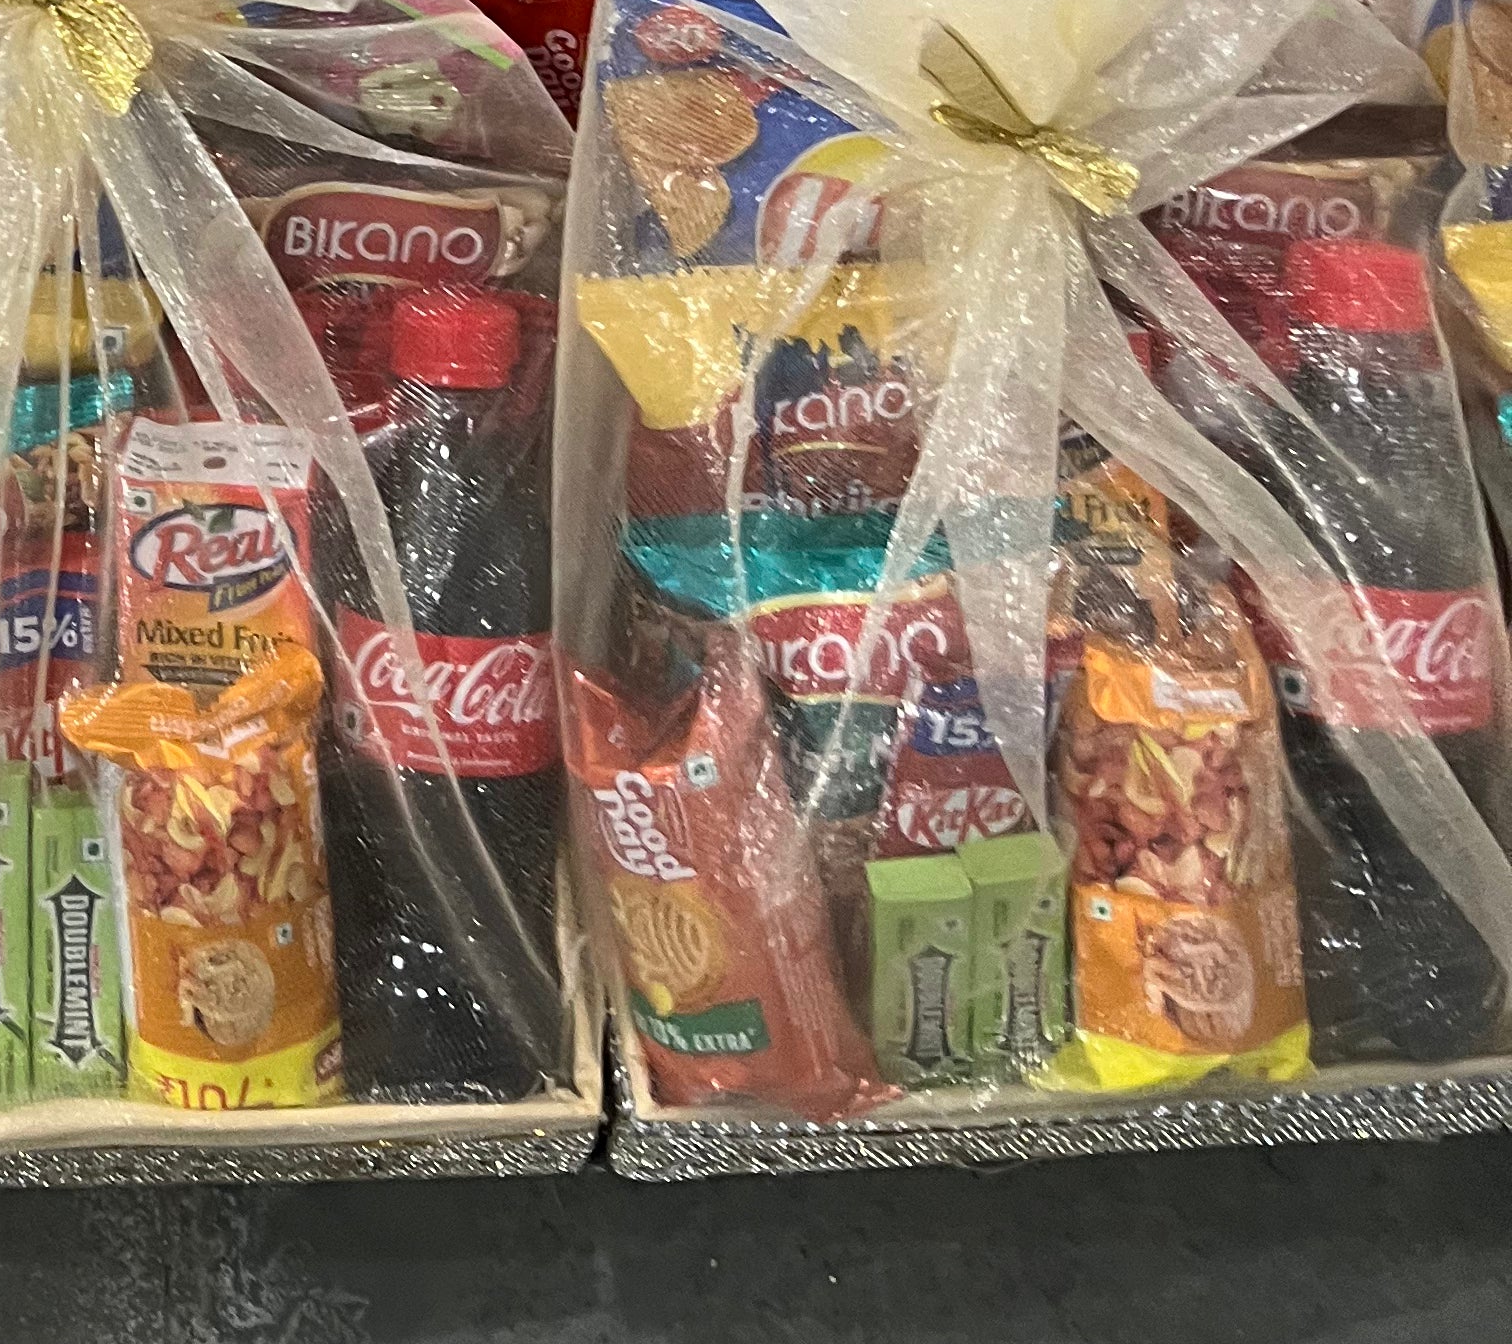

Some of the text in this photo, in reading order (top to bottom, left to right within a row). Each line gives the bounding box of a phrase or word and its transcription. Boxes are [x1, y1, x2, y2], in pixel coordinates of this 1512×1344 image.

[152, 522, 276, 585] Real
[136, 617, 224, 648] Mixed
[594, 790, 657, 877] Day
[616, 771, 697, 881] Good
[61, 894, 92, 1052] DOUBLEMINT
